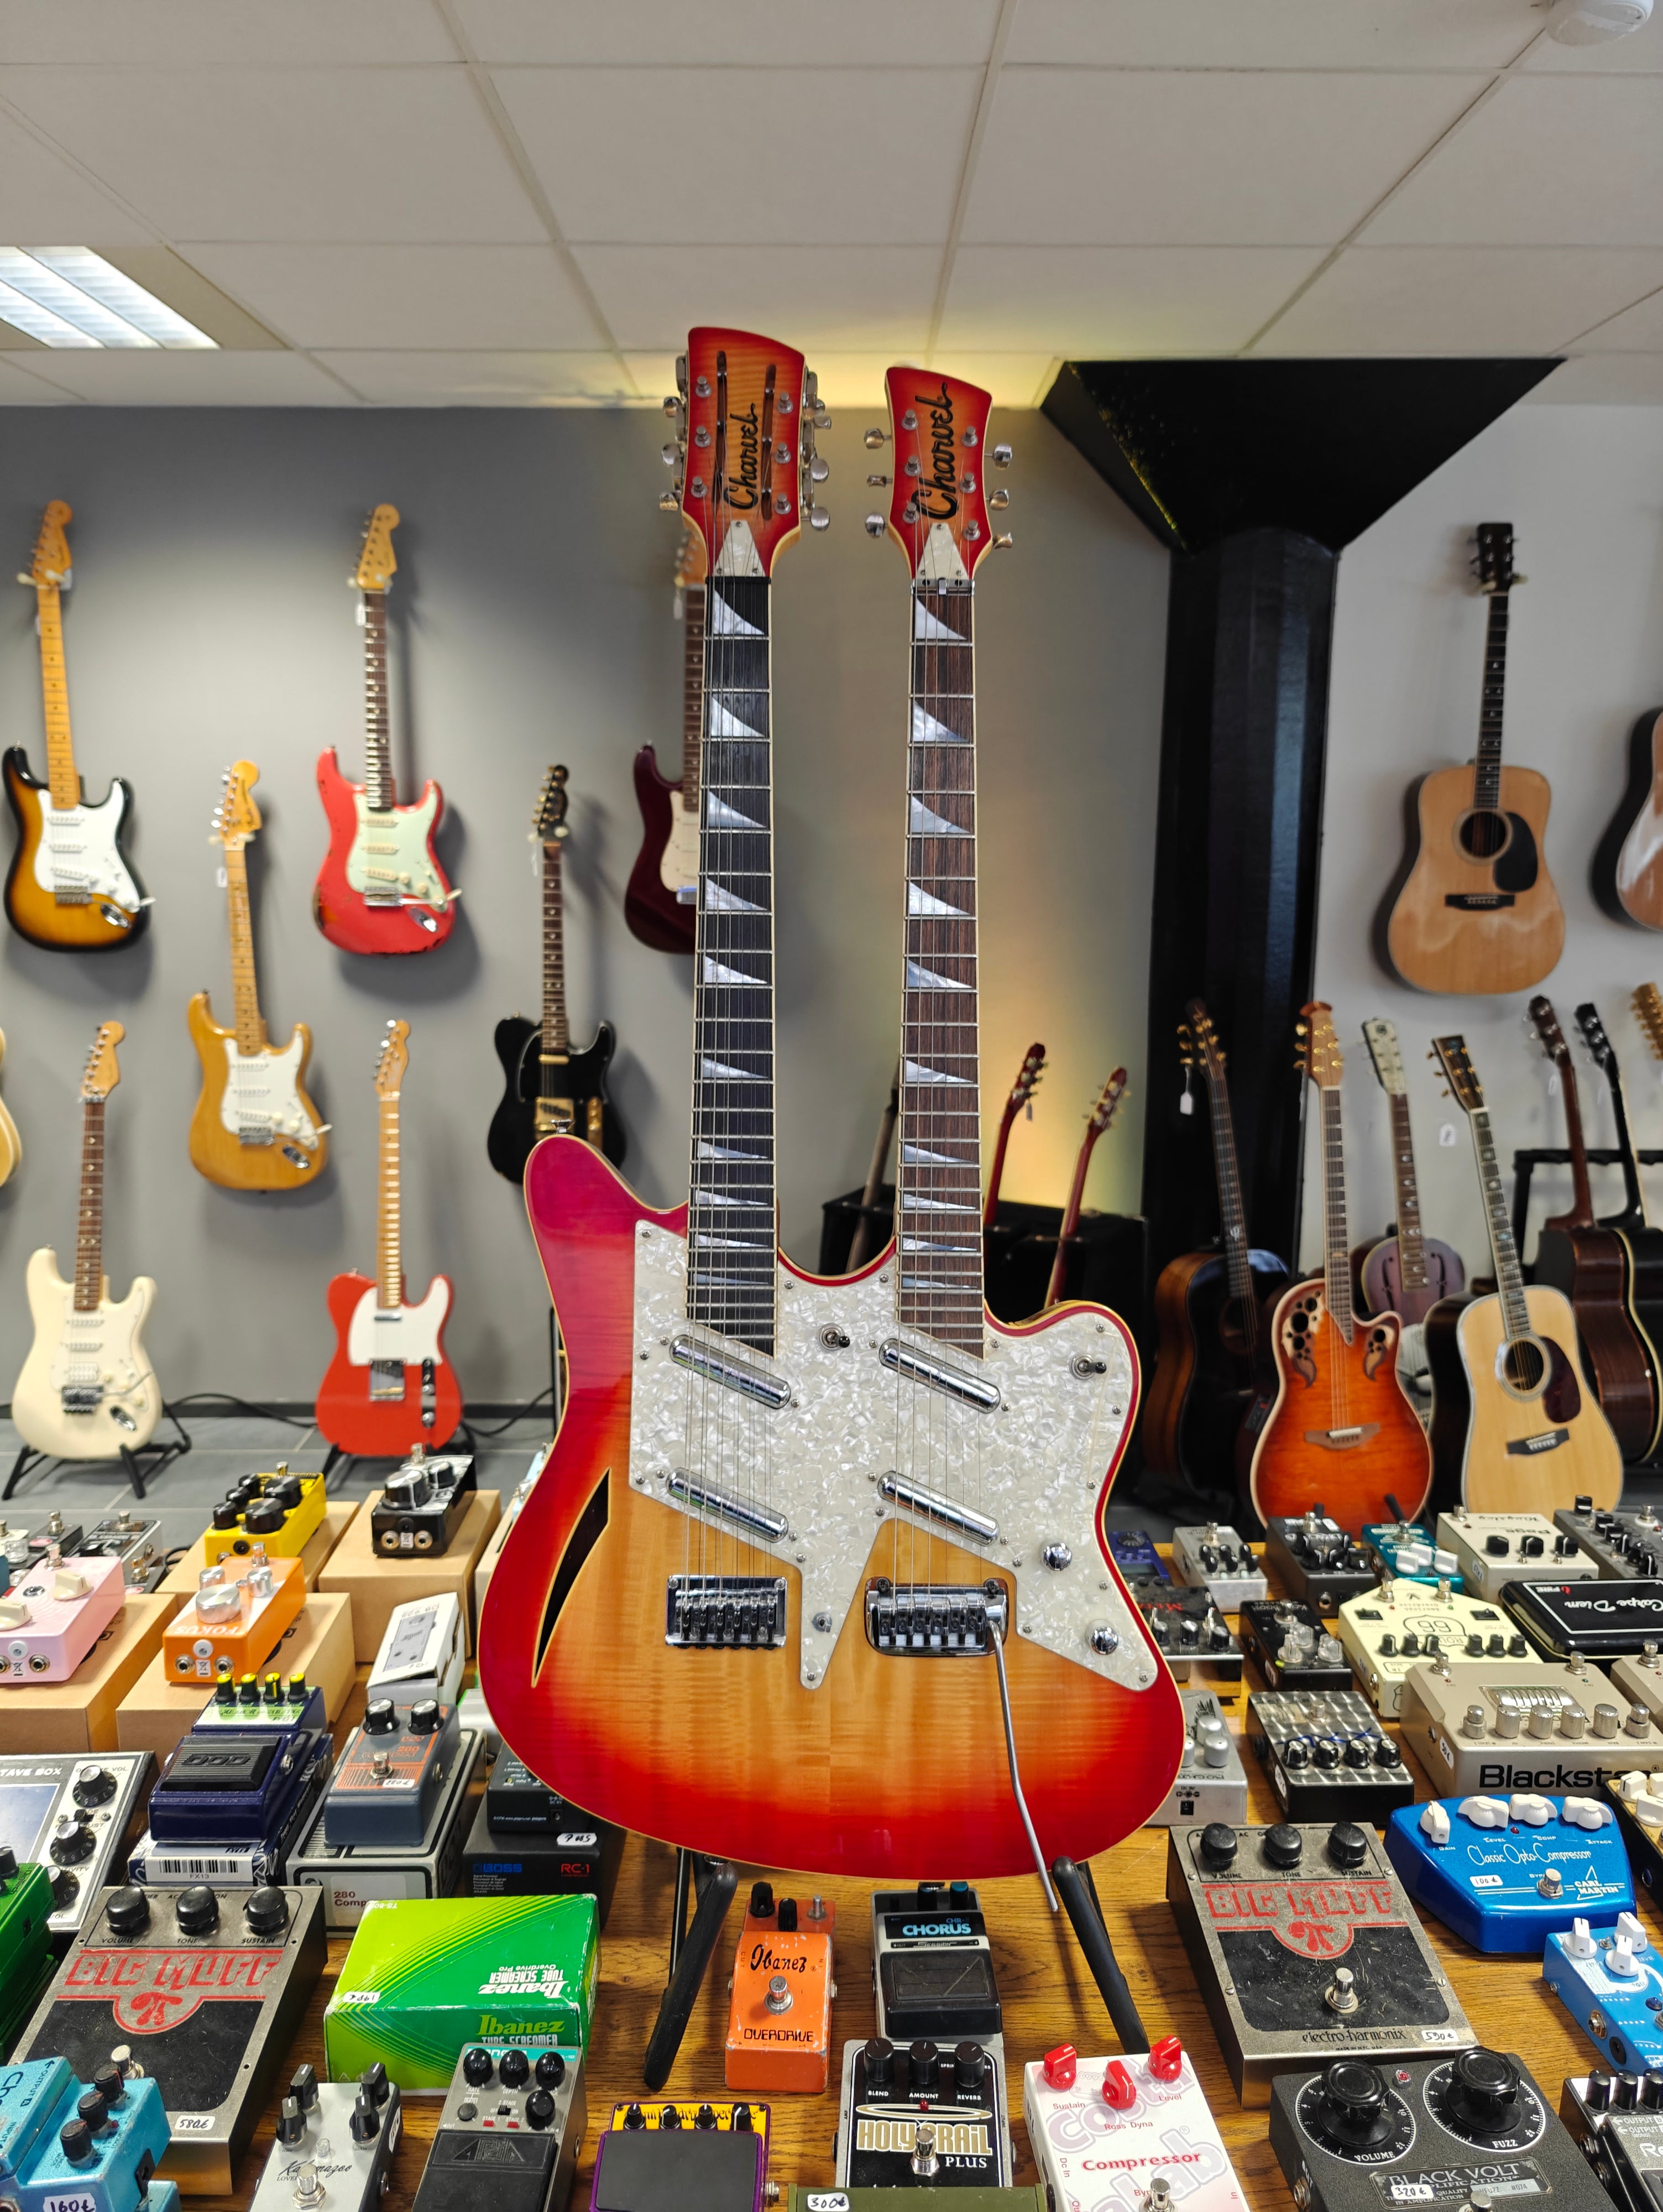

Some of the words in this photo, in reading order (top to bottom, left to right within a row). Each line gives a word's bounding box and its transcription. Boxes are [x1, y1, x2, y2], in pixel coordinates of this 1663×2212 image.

[723, 403, 759, 510] Charvel
[911, 382, 960, 520] Charvel
[1563, 1599, 1616, 1613] Diem
[175, 1624, 239, 1636] FOKUS
[1416, 1620, 1452, 1632] 66
[1439, 1636, 1465, 1645] ROU
[181, 1754, 251, 1766] DOD
[1467, 1845, 1507, 1866] Classic
[483, 1863, 522, 1873] BOSS
[561, 1863, 590, 1873] RC-1
[1578, 1886, 1619, 1895] MARTIN
[1205, 1888, 1279, 1919] BIG
[1285, 1886, 1392, 1920] MUFF
[902, 1923, 972, 1936] CHORUS
[750, 1944, 807, 1973] Ibanez
[64, 1955, 151, 1987] BIG
[153, 1955, 281, 1991] MUFF
[489, 1971, 537, 1984] SCREAMER
[541, 1970, 564, 1981] TUBE
[478, 1980, 569, 2000] Ibanez
[476, 2015, 566, 2036] Ibanez
[744, 2028, 814, 2042] OVERDRIVE
[1301, 2027, 1409, 2044] electro-harmonix
[1158, 2093, 1182, 2101] Level
[1053, 2102, 1086, 2110] Sustain
[1104, 2122, 1127, 2131] Ross
[1129, 2120, 1154, 2130] Dyna
[856, 2119, 917, 2152] HOLY
[1492, 2139, 1518, 2148] FUZZ
[945, 2157, 987, 2168] PLUS
[1081, 2152, 1202, 2172] Compressor
[1354, 2150, 1395, 2162] VOLUME
[278, 2159, 353, 2178] Kamazoo
[1388, 2168, 1463, 2185] BLACK
[1464, 2163, 1521, 2179] VOLT
[1430, 2175, 1514, 2189] PLIFICATION
[1511, 2183, 1528, 2191] #074
[1436, 2188, 1469, 2197] QUALITY
[1406, 2194, 1466, 2205] AMPLIFICATION
